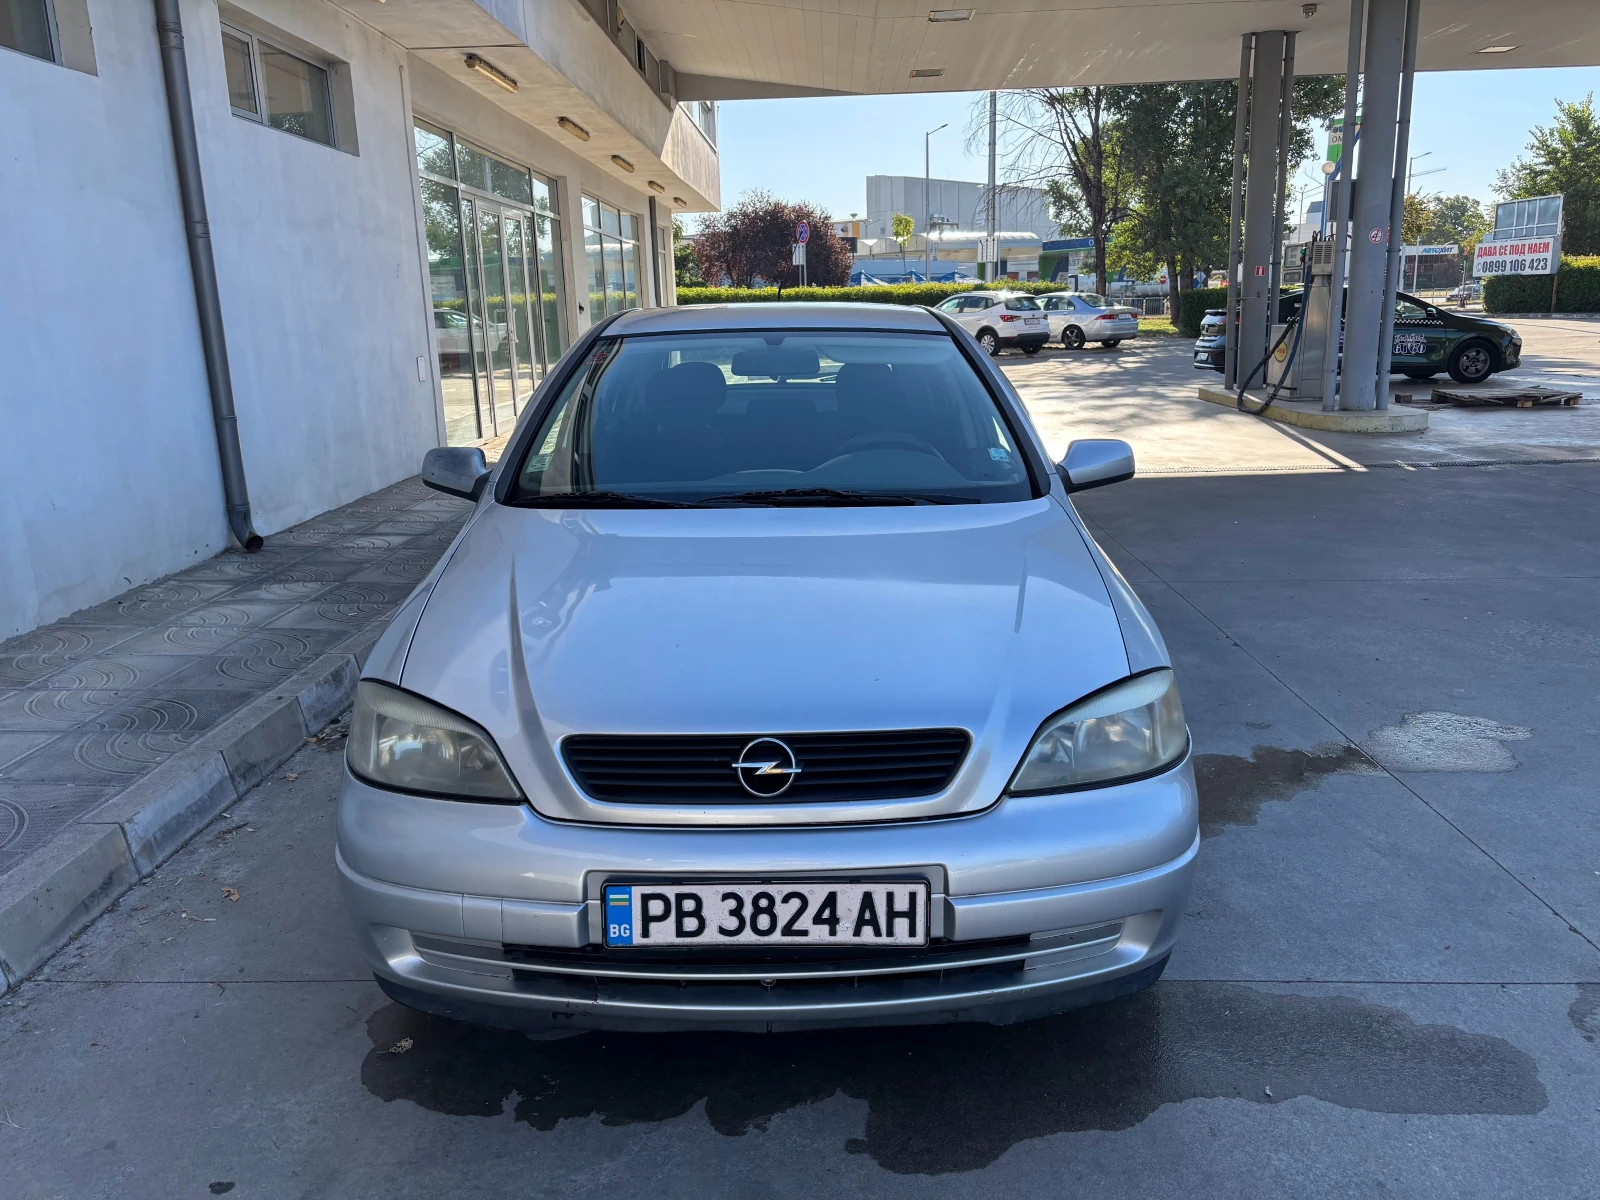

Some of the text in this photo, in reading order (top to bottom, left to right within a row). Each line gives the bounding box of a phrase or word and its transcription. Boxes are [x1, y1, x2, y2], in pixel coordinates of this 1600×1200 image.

[1421, 246, 1454, 254] АВТОХИТ
[1477, 242, 1550, 259] ДАВА СЕ ПОД НАЕМ
[1482, 257, 1548, 273] 0899 106 423
[641, 891, 917, 938] PB 3824 AH
[609, 923, 630, 938] BG
